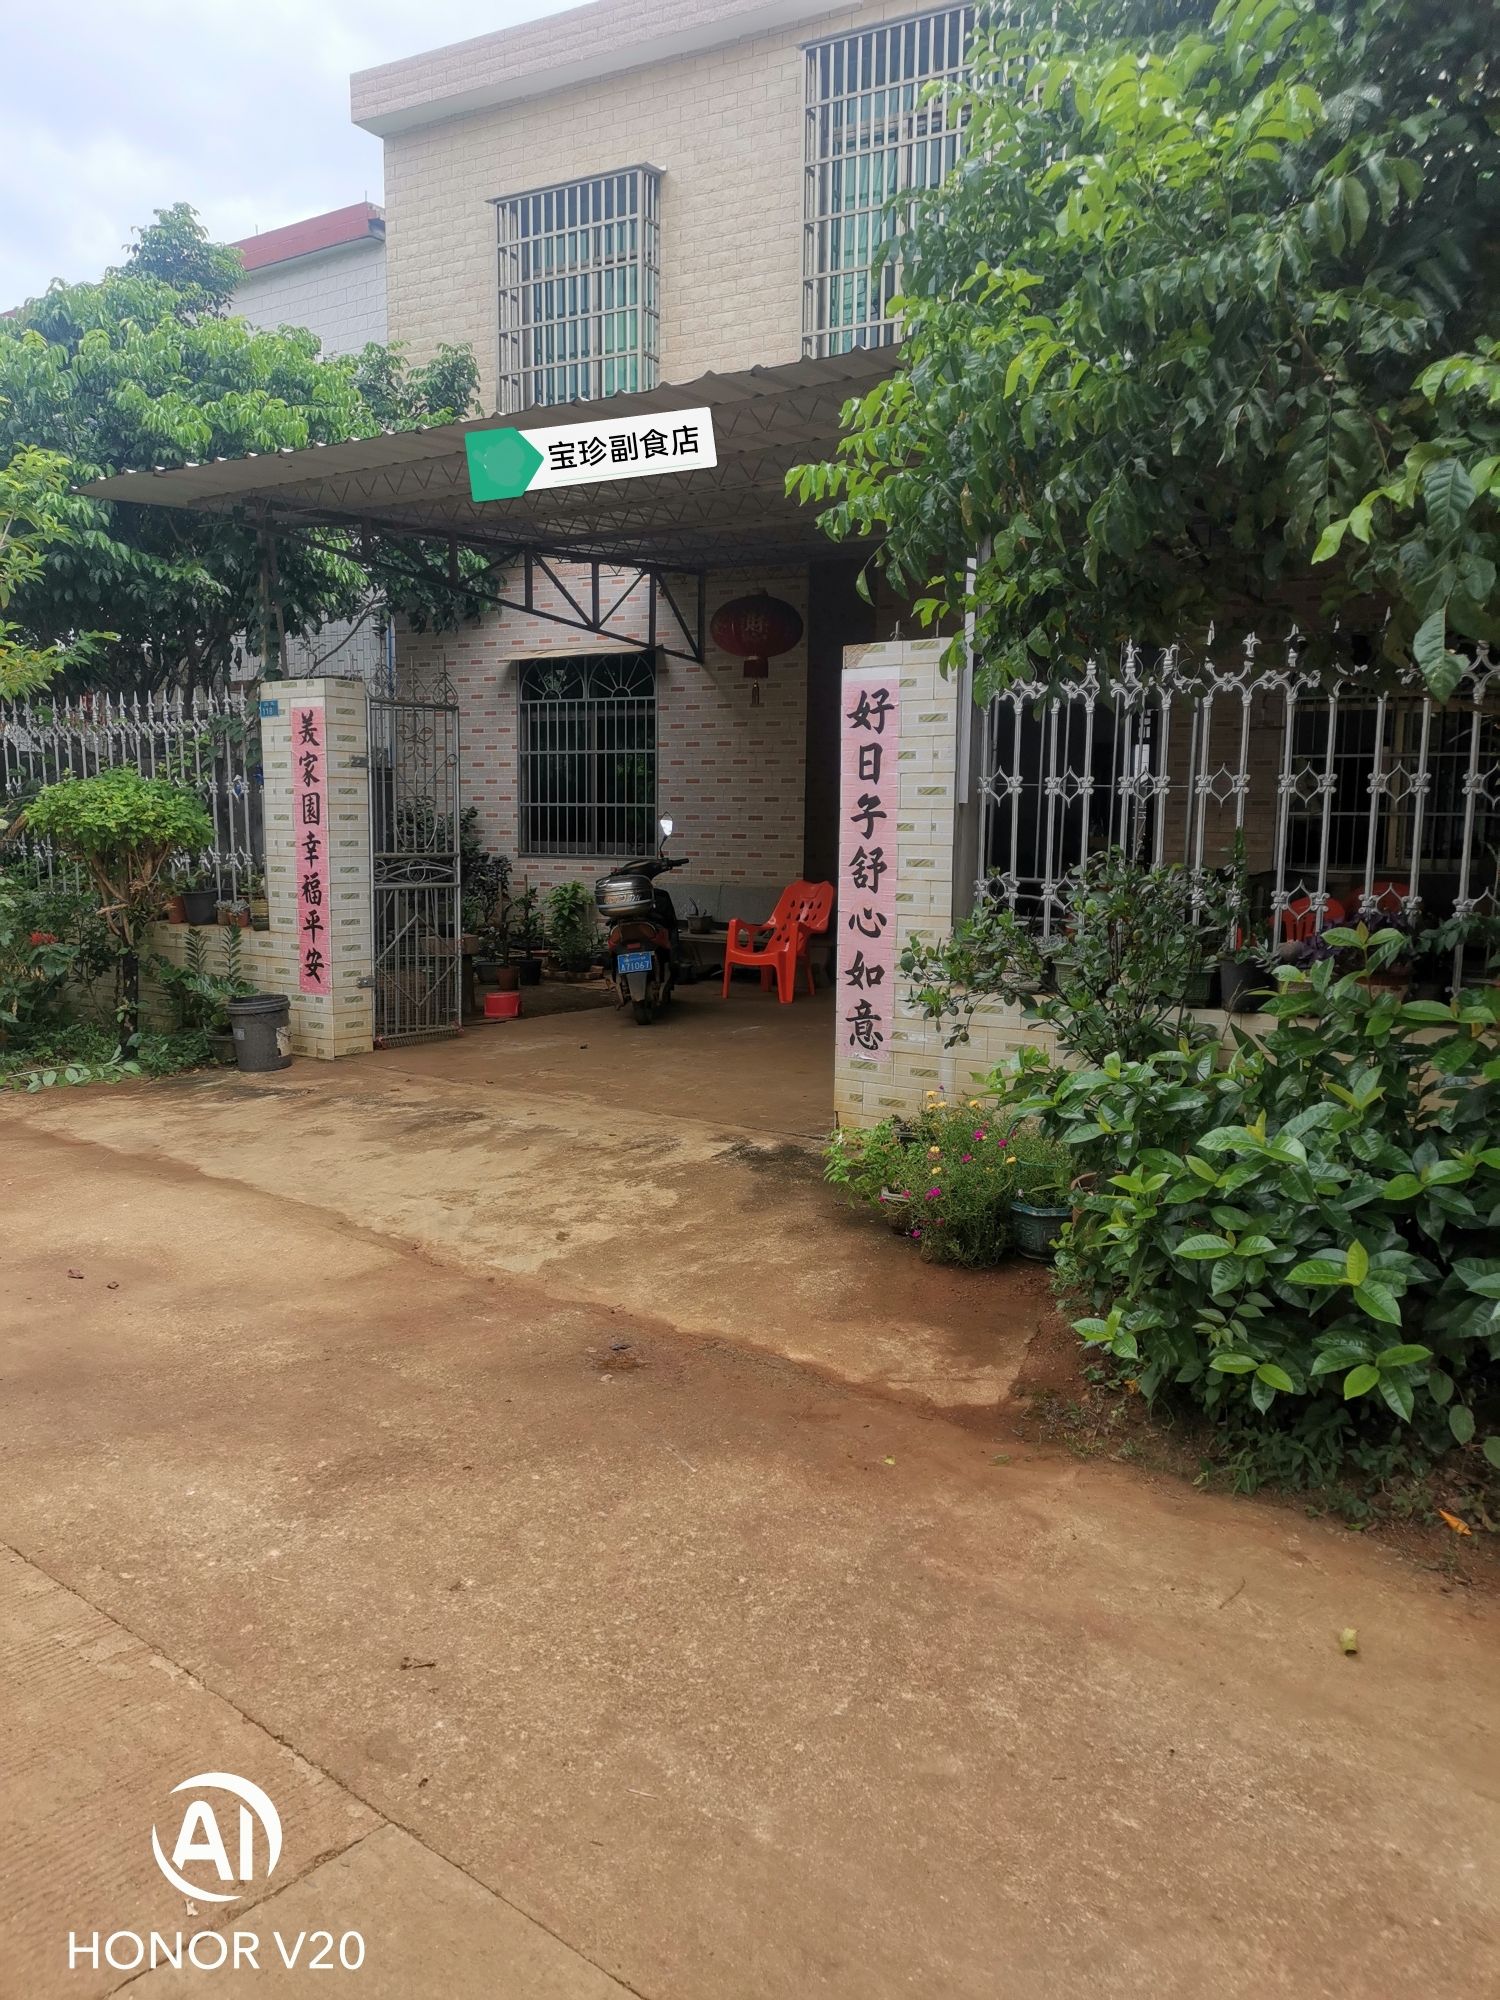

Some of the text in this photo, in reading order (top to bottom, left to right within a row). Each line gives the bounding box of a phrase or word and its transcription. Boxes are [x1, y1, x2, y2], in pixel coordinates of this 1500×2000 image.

[846, 688, 895, 1051] 好日子舒心如意
